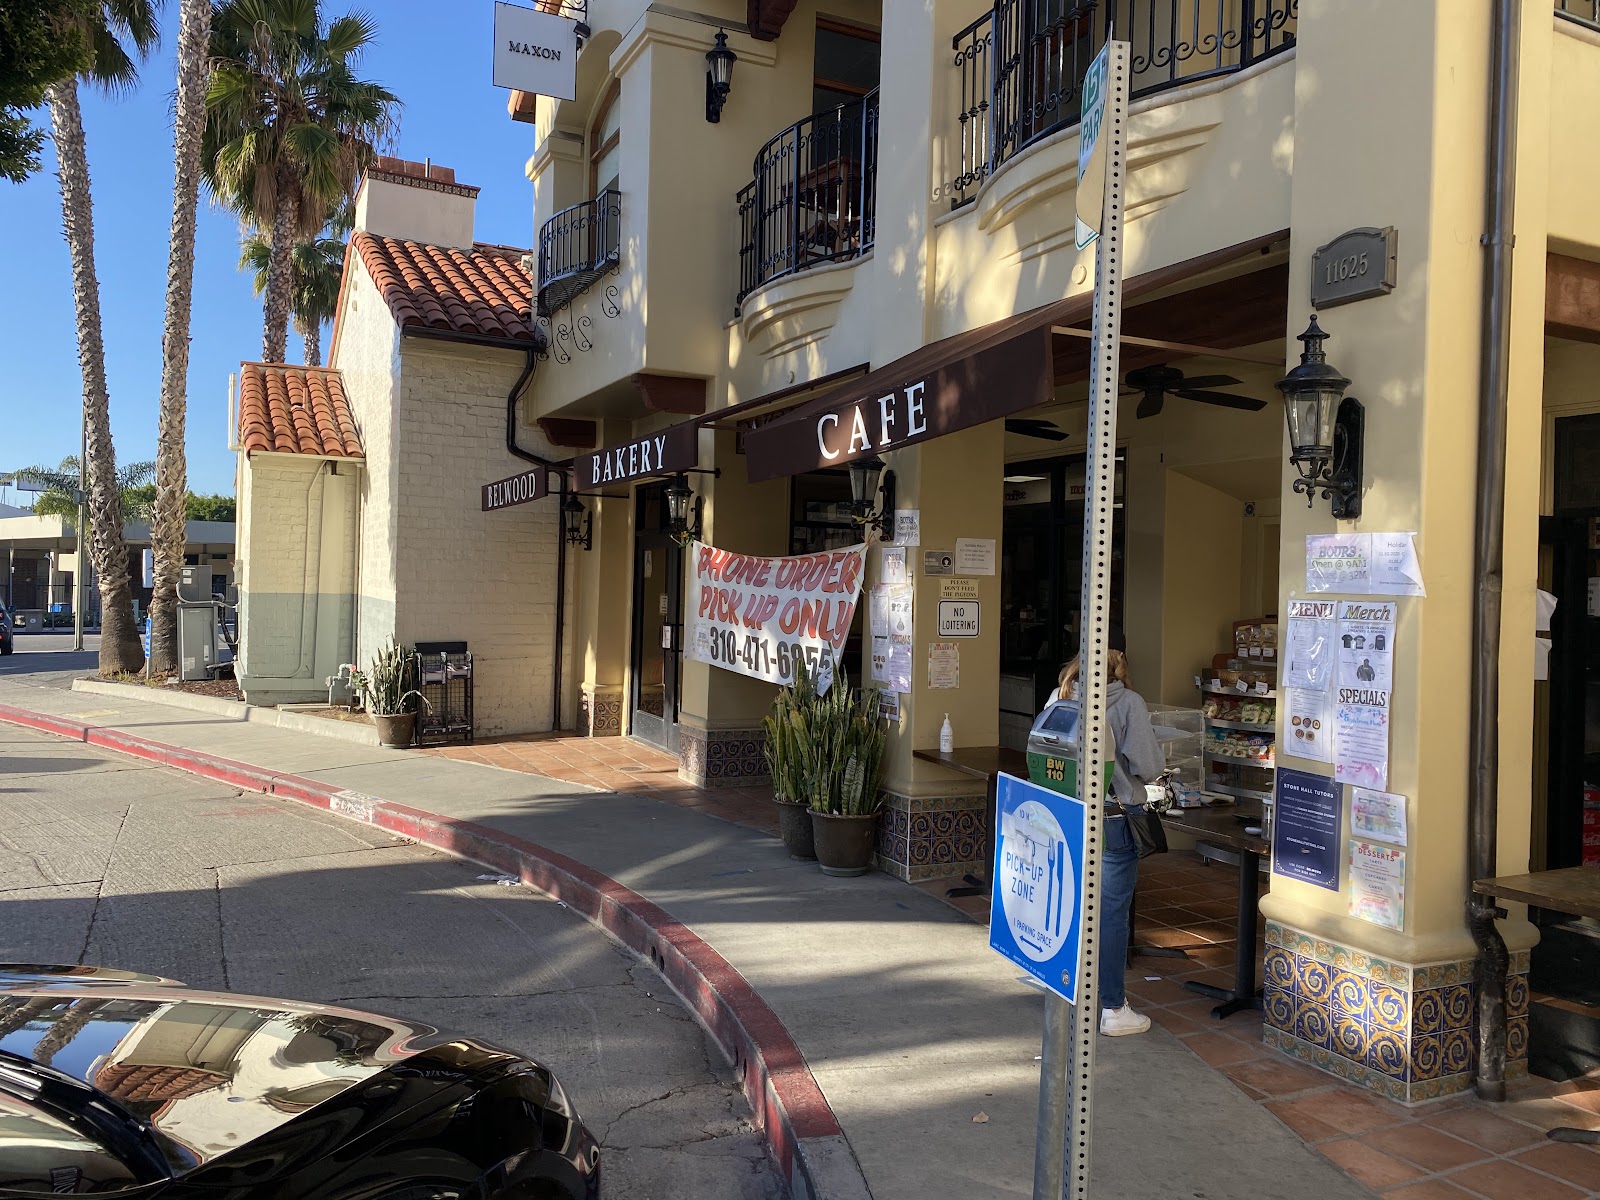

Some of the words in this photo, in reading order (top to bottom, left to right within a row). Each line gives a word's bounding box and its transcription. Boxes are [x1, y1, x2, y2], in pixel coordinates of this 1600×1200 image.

[508, 40, 562, 61] MAXON
[1084, 62, 1099, 109] 15
[1326, 251, 1369, 284] 11625
[816, 380, 929, 460] CAFE
[592, 434, 667, 485] BAKERY
[487, 472, 537, 508] BELWOOD
[698, 546, 774, 588] PHONE
[775, 551, 862, 595] ORDER
[698, 585, 743, 626] PICK
[743, 593, 779, 631] UP
[779, 596, 854, 650] ONLY
[953, 607, 965, 617] NO
[1289, 602, 1335, 618] MENU
[1342, 604, 1391, 621] Merch
[942, 620, 976, 630] LOITERING
[1338, 688, 1386, 707] SPECIALS
[1046, 757, 1065, 771] BW
[1046, 769, 1064, 782] 110
[1283, 783, 1300, 791] STONE
[1300, 786, 1313, 794] HALL
[1314, 789, 1334, 799] TUTORS
[1358, 847, 1395, 862] DESSERTS
[1006, 851, 1044, 883] PICK-UP
[1011, 876, 1035, 903] ZONE
[1016, 919, 1036, 939] PARKING
[1036, 931, 1053, 949] SPACE
